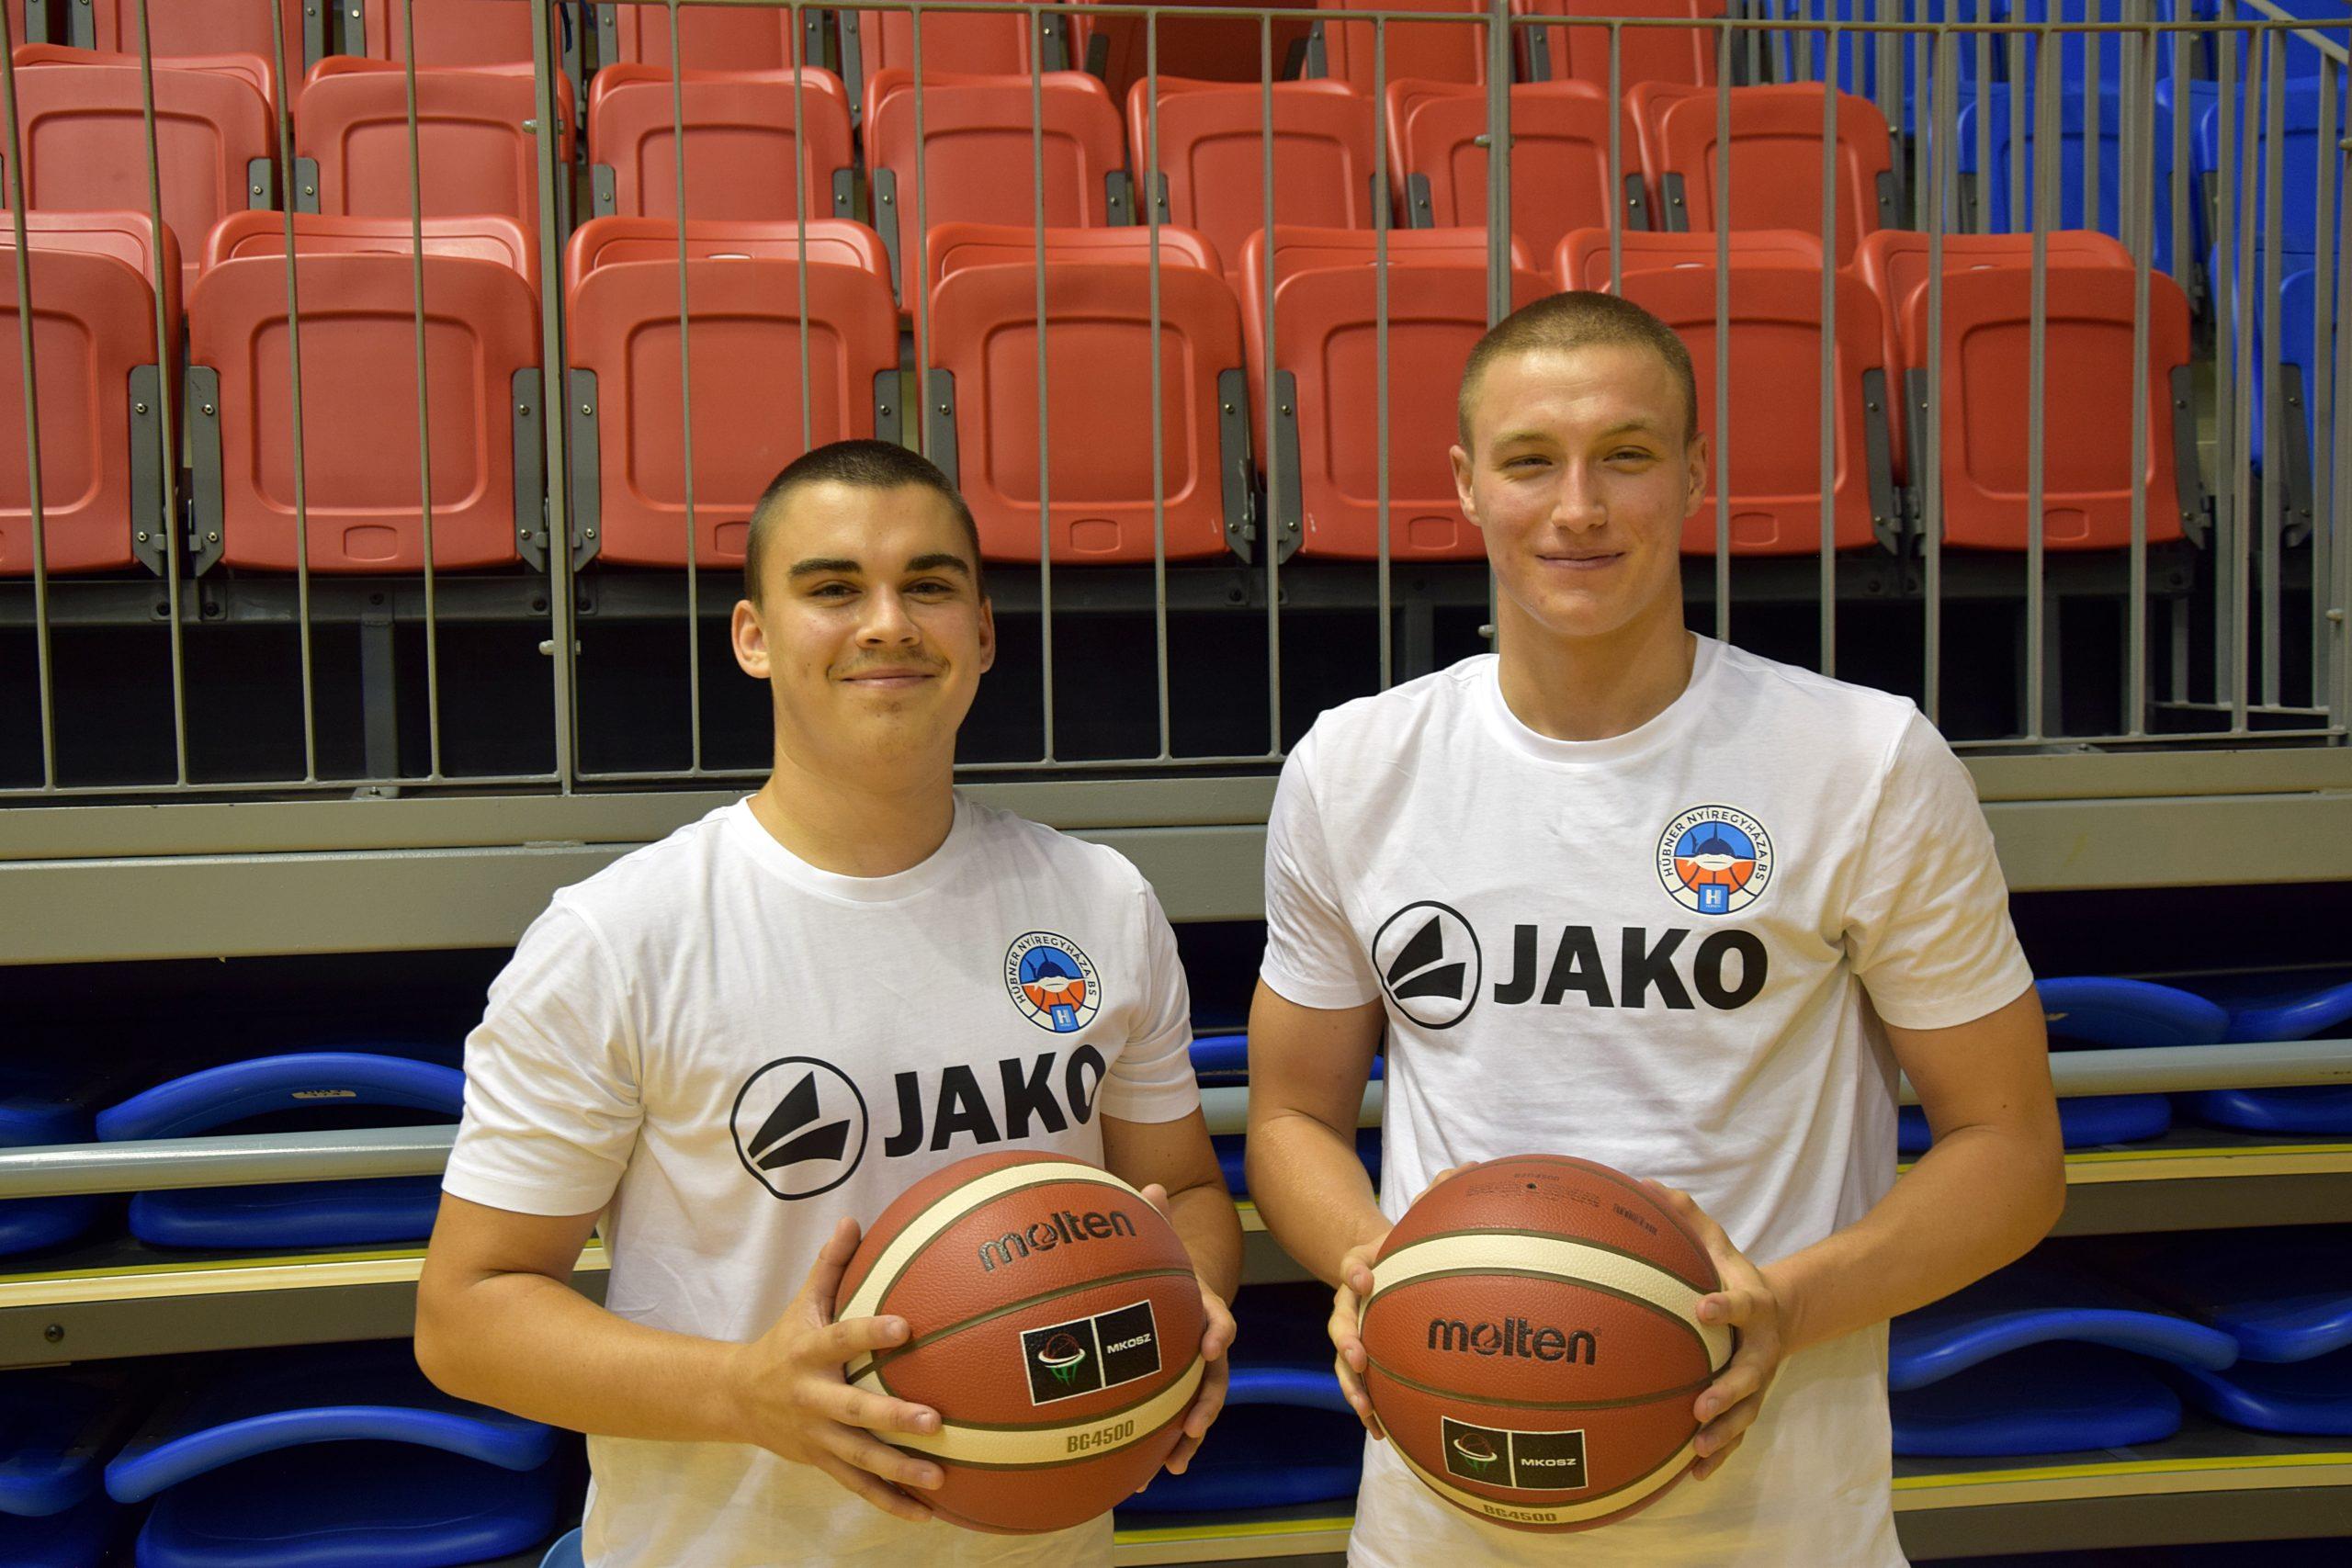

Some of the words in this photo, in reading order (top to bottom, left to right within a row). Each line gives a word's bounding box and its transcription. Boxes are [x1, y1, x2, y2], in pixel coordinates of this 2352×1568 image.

[1659, 822, 1685, 876] HÜBNER
[1687, 808, 1768, 858] NYÍREGYHÁZA
[1756, 863, 1768, 881] BS
[1706, 889, 1721, 904] H
[1008, 952, 1026, 1003] HÜBNER
[1018, 933, 1091, 976] NYÍREGYHÁZA
[1088, 981, 1096, 996] BS
[1494, 924, 1769, 1010] JAKO
[1057, 1010, 1071, 1024] H
[885, 1044, 1106, 1157] JAKO
[978, 1211, 1136, 1271] molten
[1106, 1333, 1152, 1354] MKOSZ
[1428, 1316, 1596, 1365] molten
[1067, 1420, 1135, 1453] BG4500
[1521, 1458, 1577, 1467] MKOSZ
[1483, 1504, 1557, 1522] BG4500
